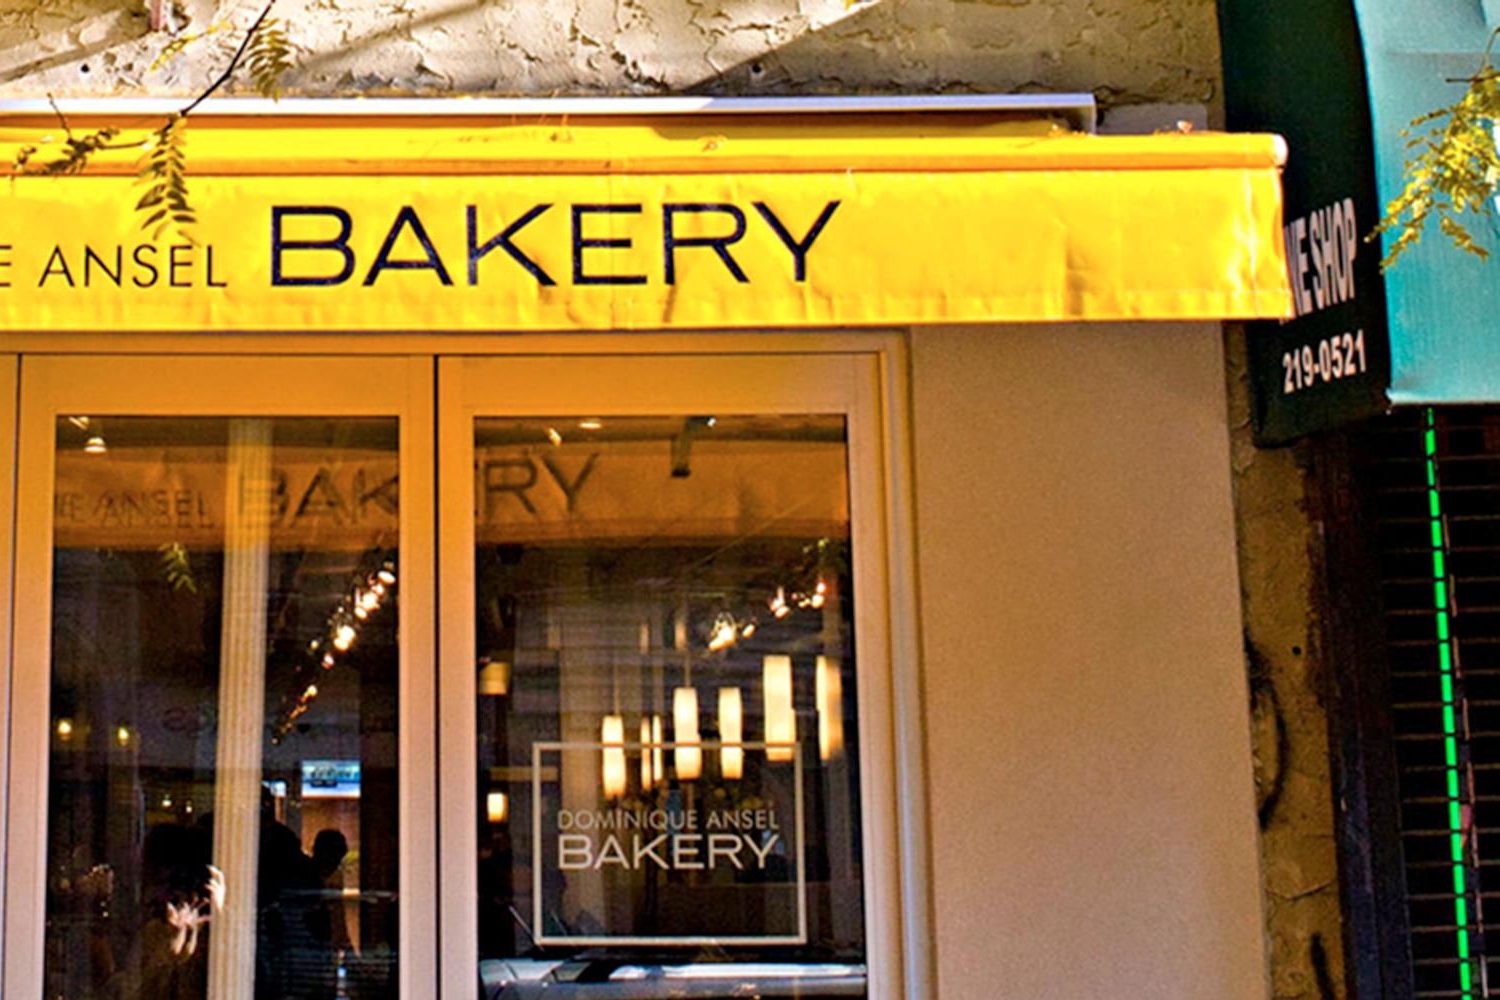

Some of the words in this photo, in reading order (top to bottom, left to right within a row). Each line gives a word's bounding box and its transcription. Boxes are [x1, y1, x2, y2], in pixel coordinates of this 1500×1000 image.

[37, 243, 227, 289] ANSEL
[270, 200, 842, 288] BAKERY
[1308, 197, 1358, 311] SHOP
[1282, 328, 1367, 394] 219-0521
[557, 809, 698, 831] DOMINIQUE
[706, 809, 779, 830] ANSEL
[558, 833, 779, 870] BAKERY
